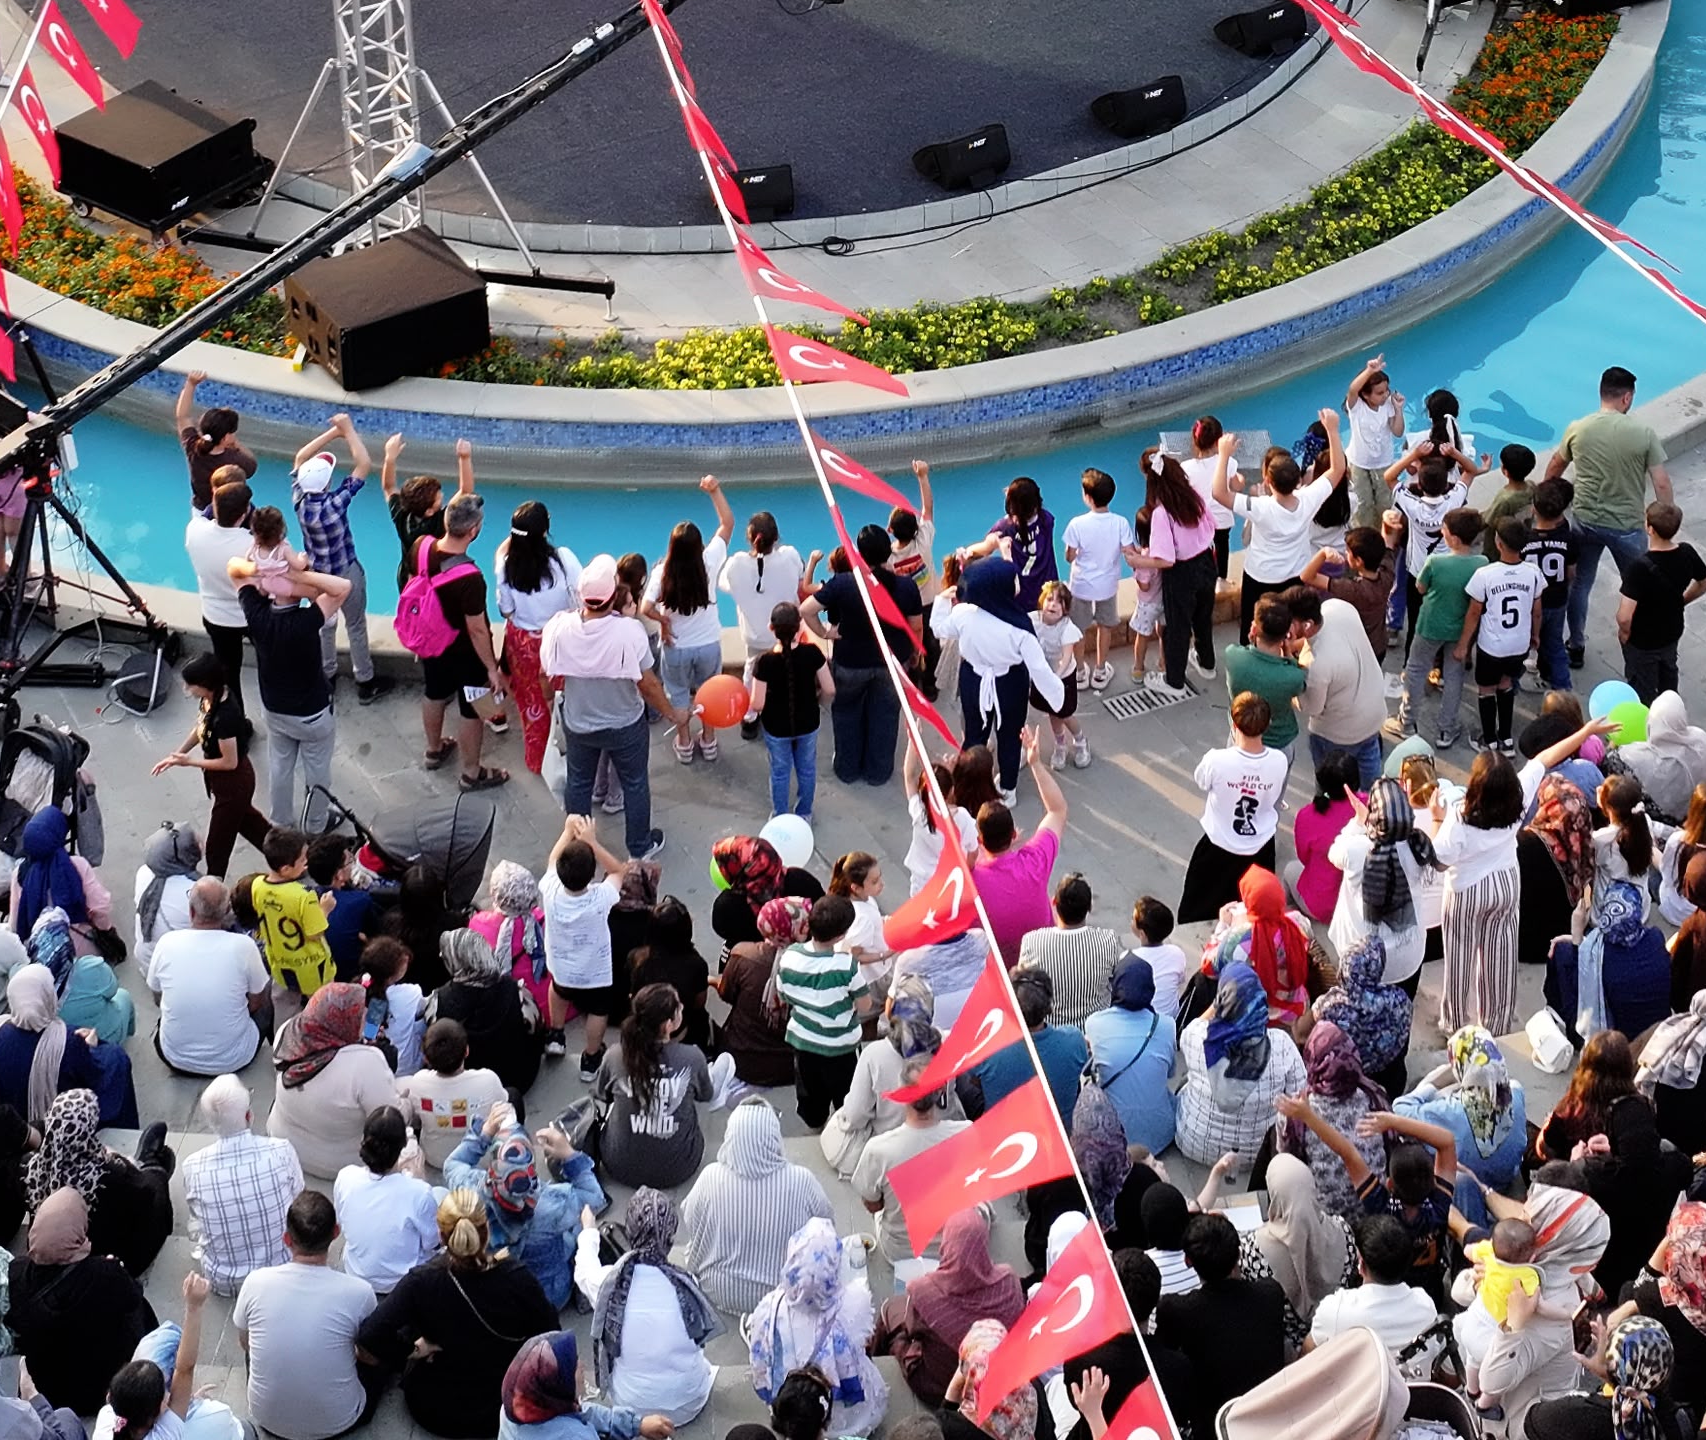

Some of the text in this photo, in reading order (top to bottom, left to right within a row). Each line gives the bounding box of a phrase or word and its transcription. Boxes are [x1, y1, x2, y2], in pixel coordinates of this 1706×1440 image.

[1501, 596, 1520, 629] 5
[1227, 781, 1273, 791] WORLD CUP
[1242, 775, 1260, 783] FIFA
[260, 910, 305, 951] 19
